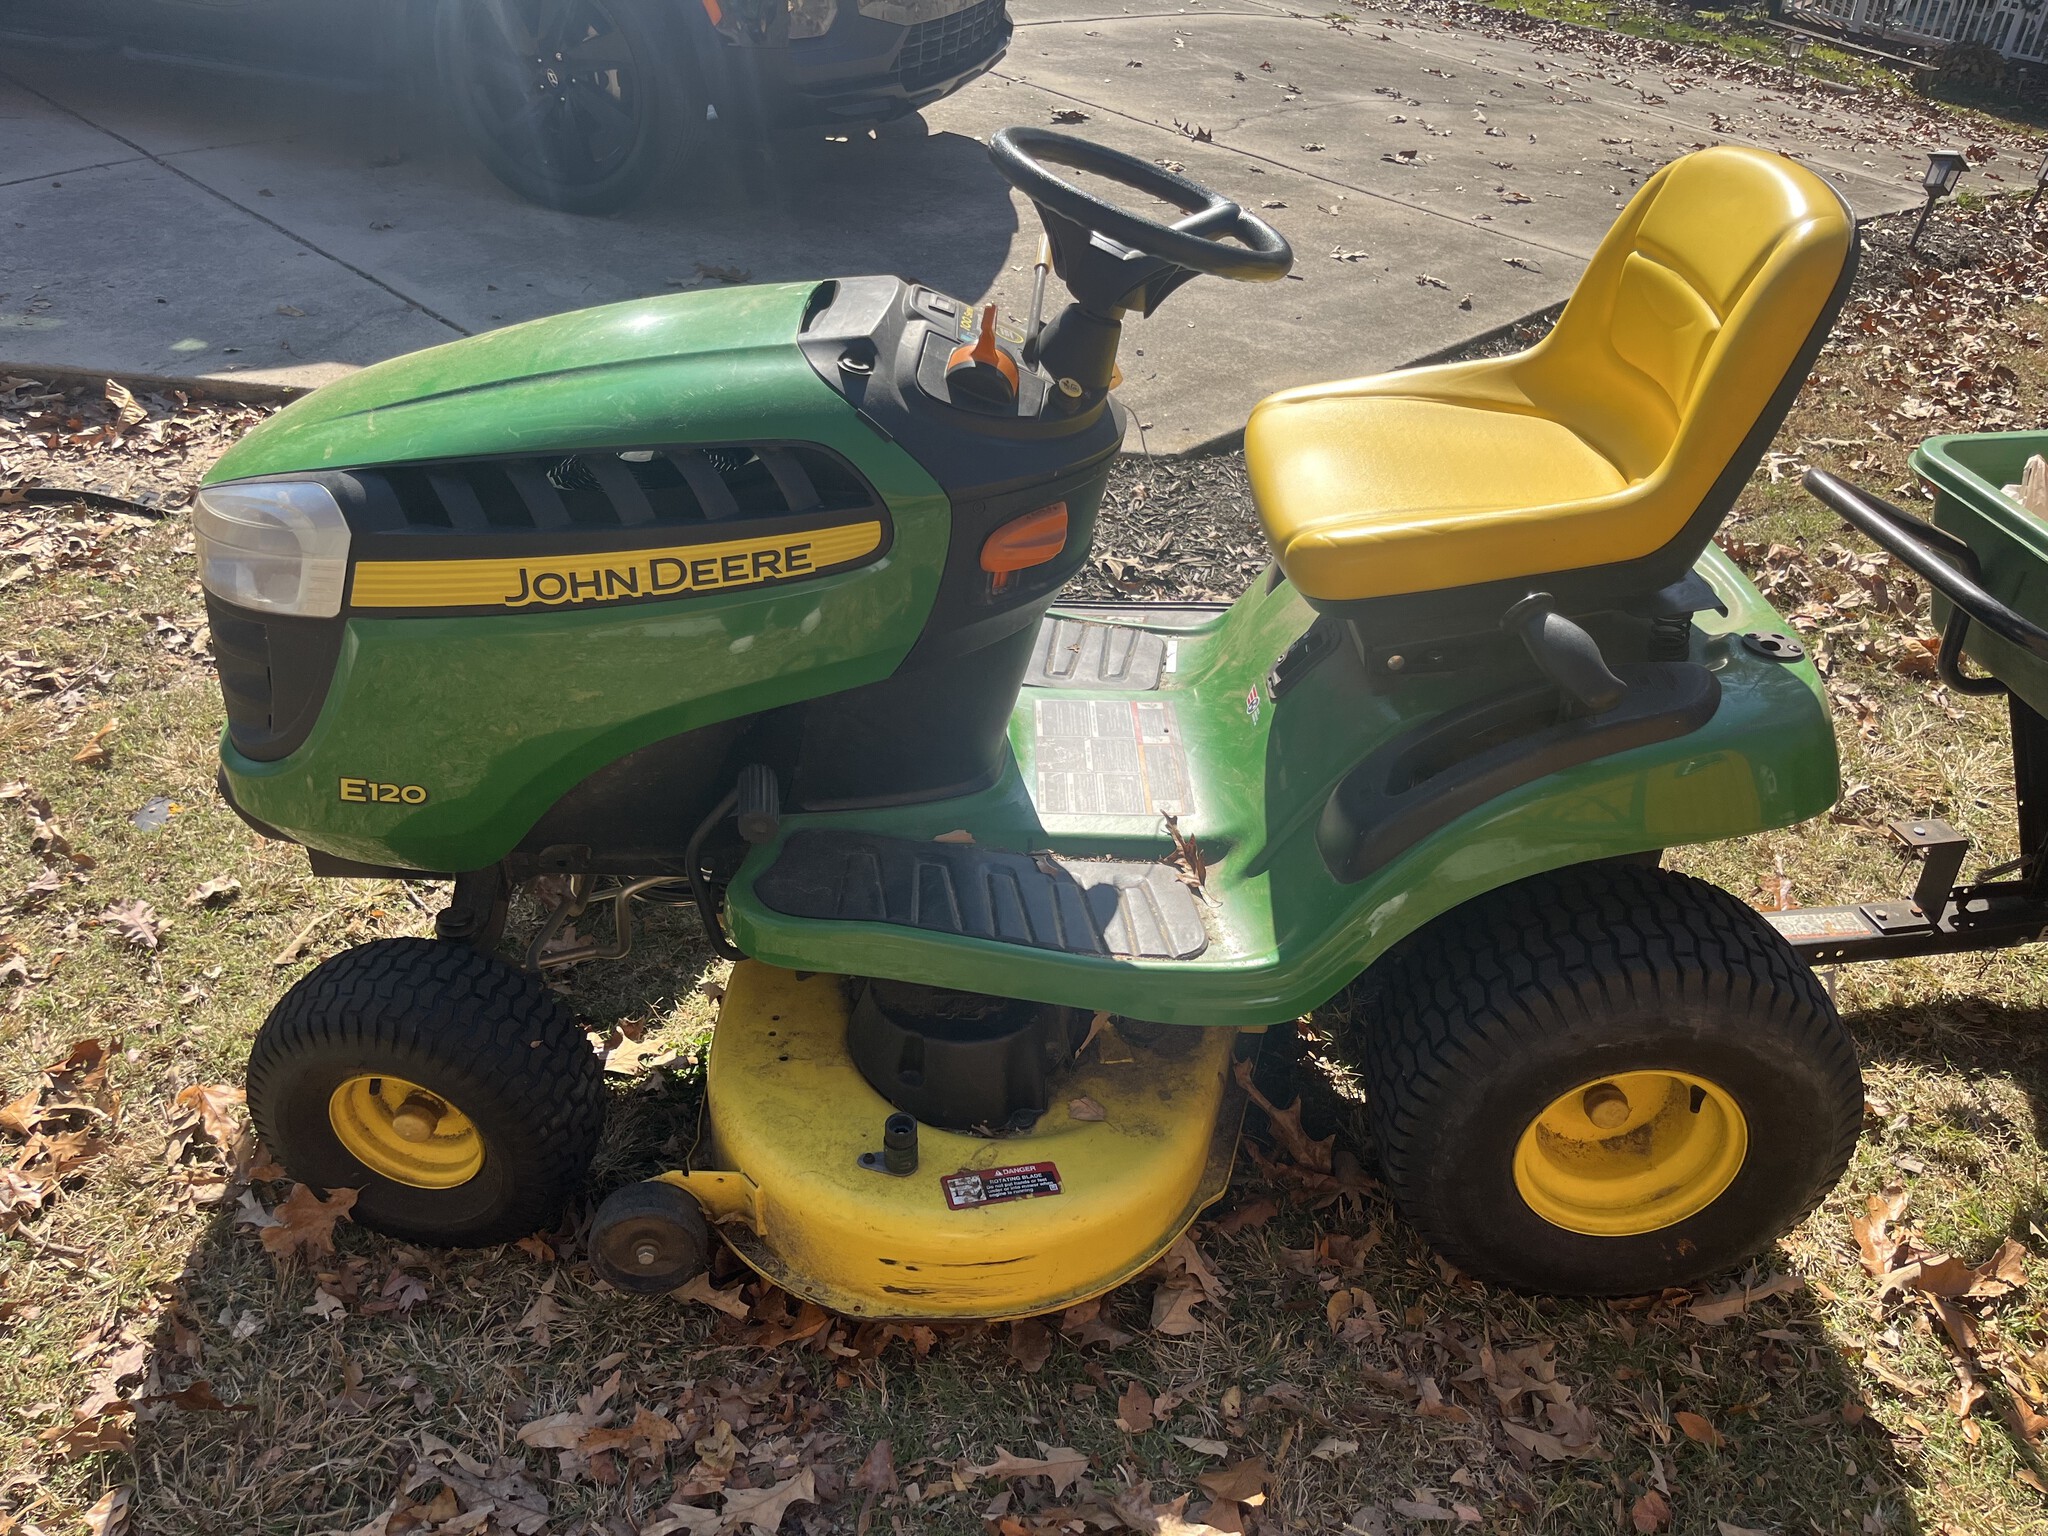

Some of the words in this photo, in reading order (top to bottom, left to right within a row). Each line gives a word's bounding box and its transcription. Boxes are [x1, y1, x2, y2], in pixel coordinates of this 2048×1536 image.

[504, 567, 638, 603] JOHN
[649, 543, 812, 591] DEERE
[340, 777, 427, 804] E120
[1002, 1165, 1037, 1175] DANGER
[989, 1175, 1021, 1184] ROTATING
